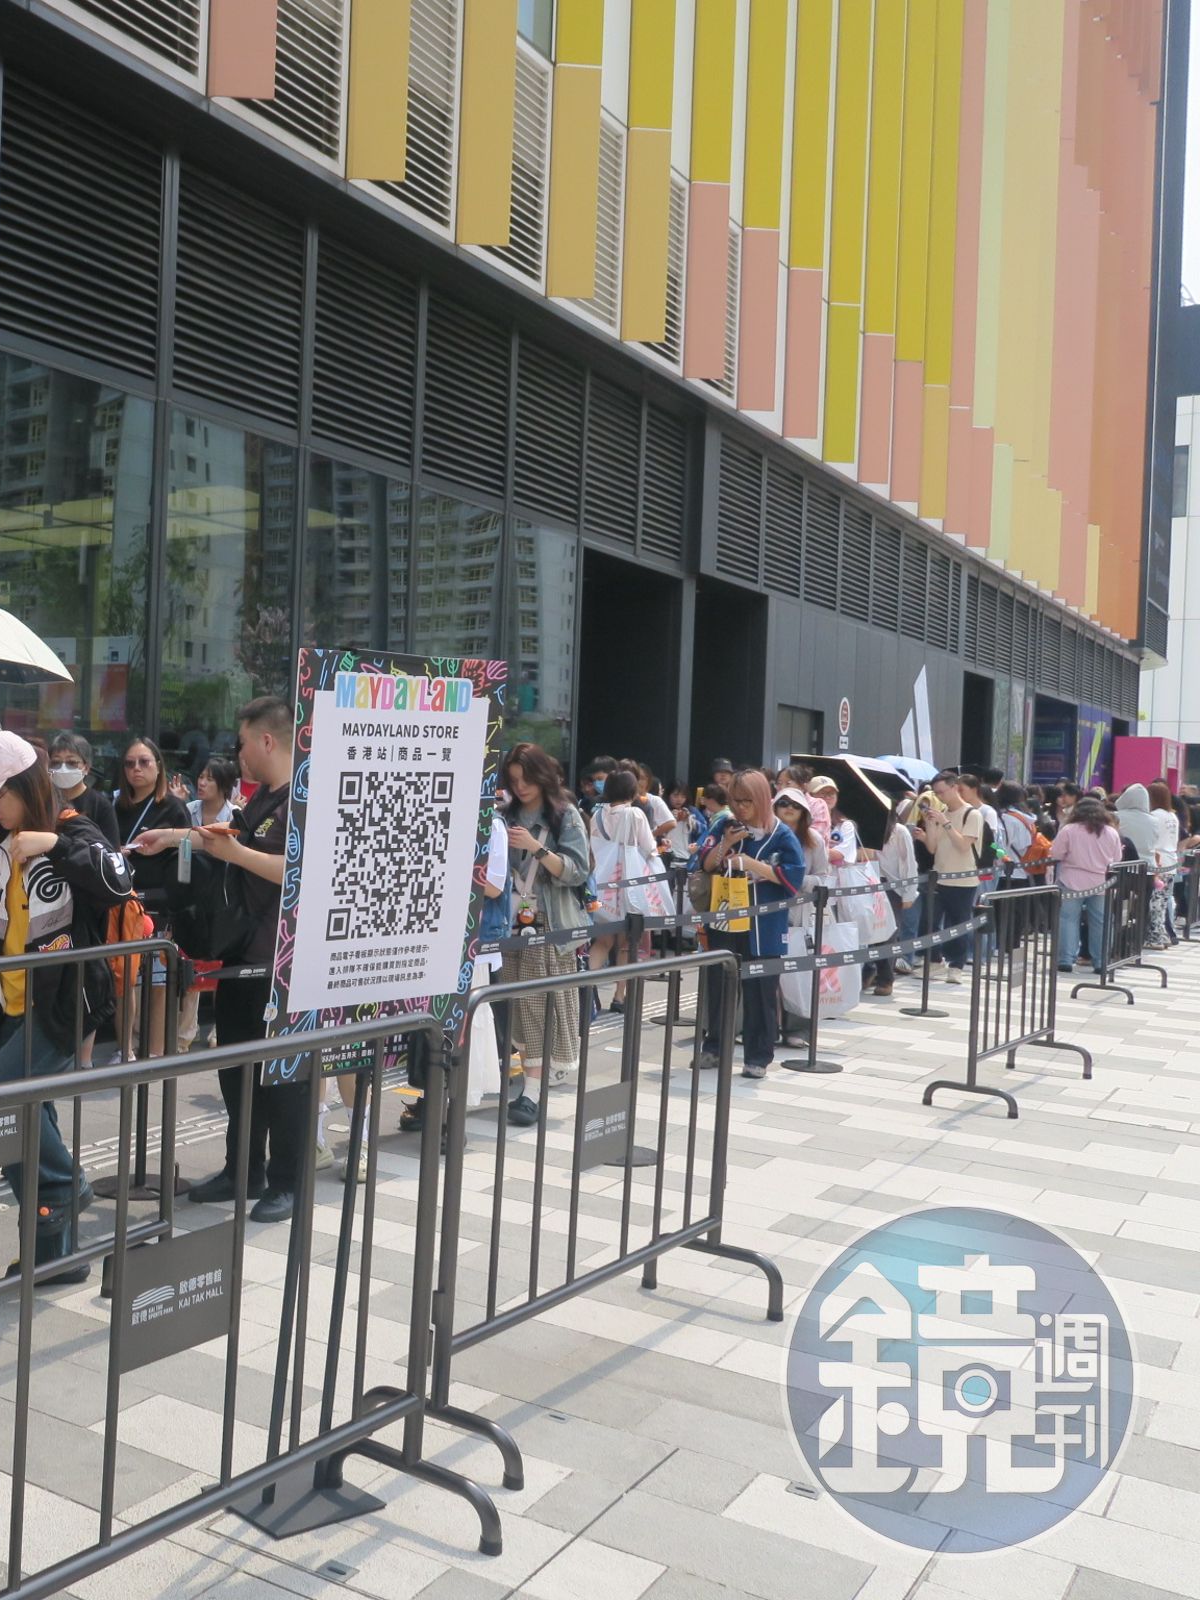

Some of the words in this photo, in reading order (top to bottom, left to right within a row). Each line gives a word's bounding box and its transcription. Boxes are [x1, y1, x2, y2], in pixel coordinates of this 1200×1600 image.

[342, 722, 420, 739] MAYDAYLAND
[422, 725, 460, 739] STORE
[179, 1298, 190, 1310] KAI
[192, 1292, 204, 1304] TAK
[206, 1286, 223, 1300] MALL
